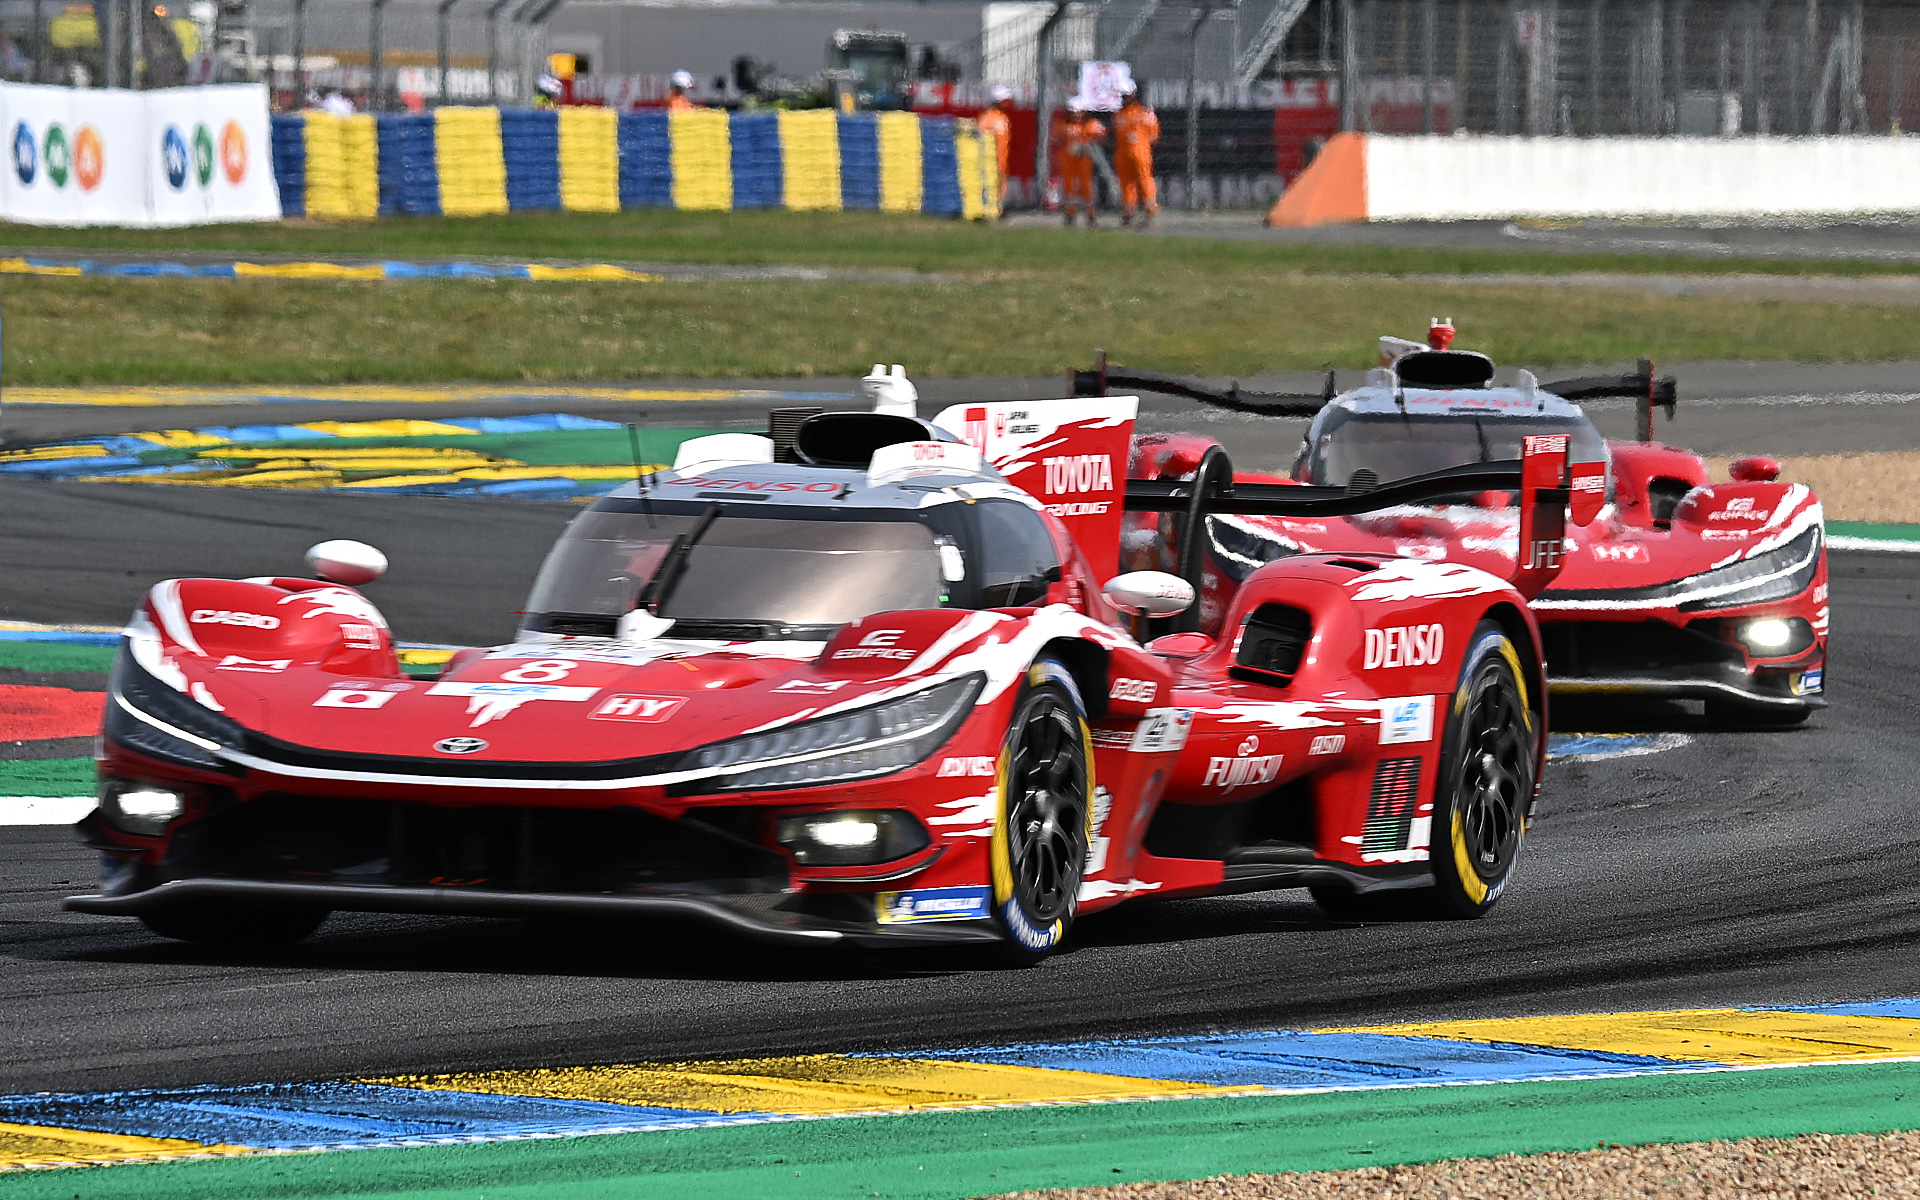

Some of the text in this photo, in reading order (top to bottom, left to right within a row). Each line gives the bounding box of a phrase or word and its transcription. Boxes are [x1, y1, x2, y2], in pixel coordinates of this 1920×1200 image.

[1410, 396, 1533, 408] DENSO
[666, 475, 844, 494] DENSO
[1042, 454, 1114, 495] TOYOTA
[1523, 539, 1561, 570] JFE
[190, 609, 281, 630] CASIO
[831, 648, 917, 660] EDIFICE
[1363, 622, 1444, 670] DENSO
[500, 660, 579, 684] 8
[605, 697, 679, 717] HY
[1202, 753, 1284, 795] FUJITSU
